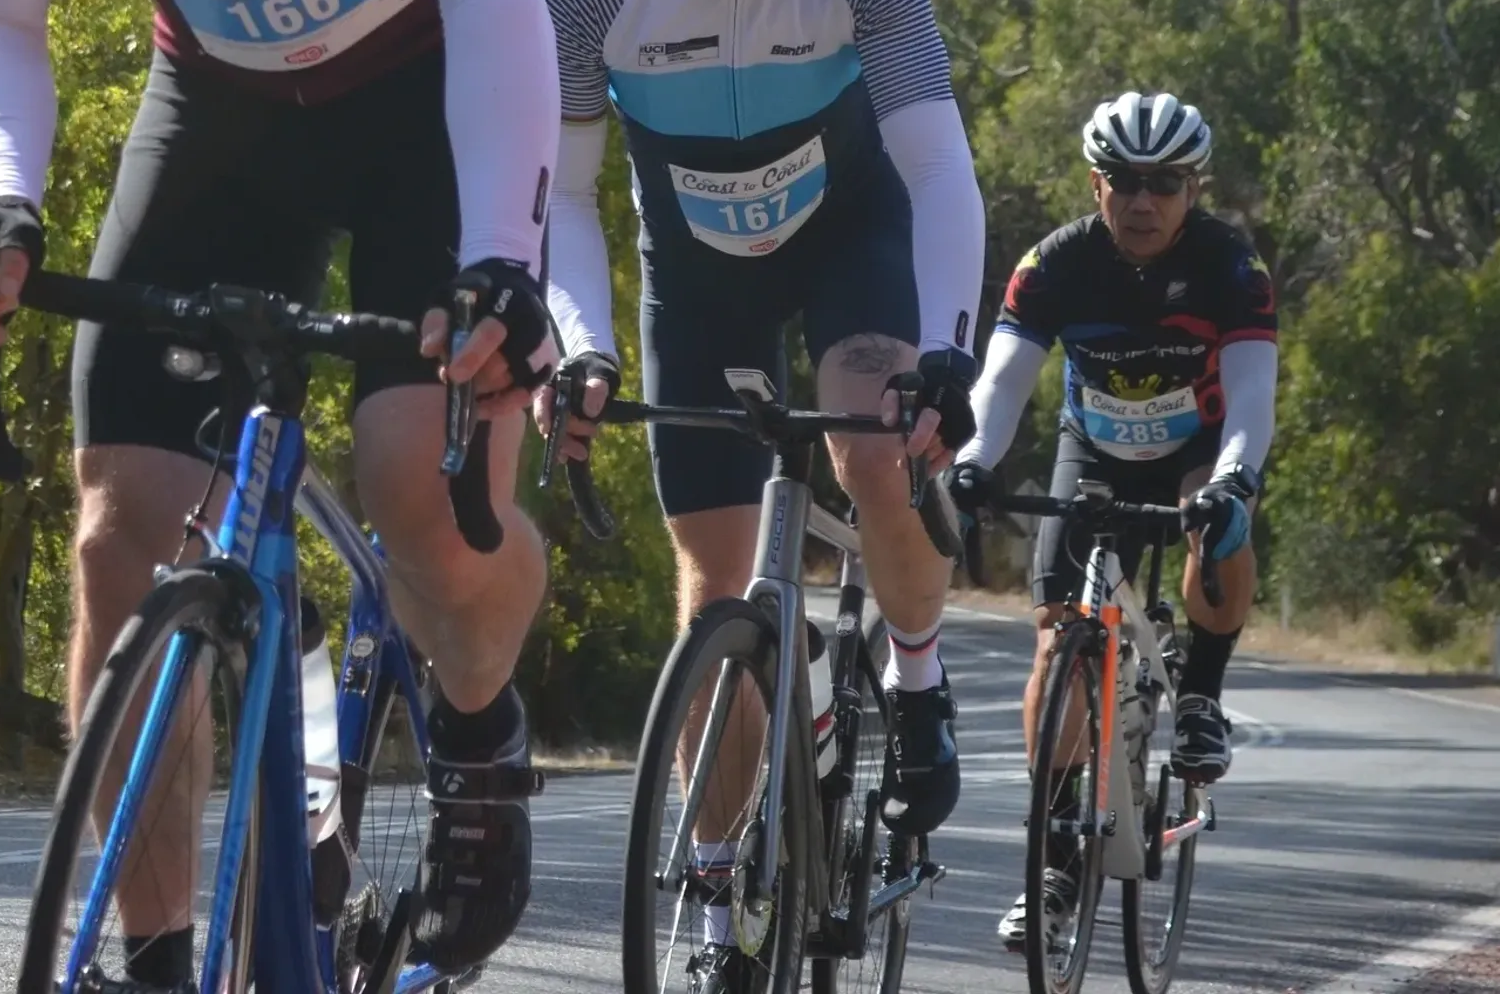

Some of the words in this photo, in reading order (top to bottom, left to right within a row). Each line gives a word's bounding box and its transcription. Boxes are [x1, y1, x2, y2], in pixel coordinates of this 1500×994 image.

[770, 41, 816, 56] Santini
[682, 173, 737, 195] Coast
[743, 181, 758, 191] to
[762, 149, 813, 189] Coast
[718, 189, 789, 232] 167
[1091, 394, 1127, 416] Coast
[1145, 395, 1187, 416] Coast
[1113, 421, 1169, 443] 285
[770, 494, 787, 565] FOCUS
